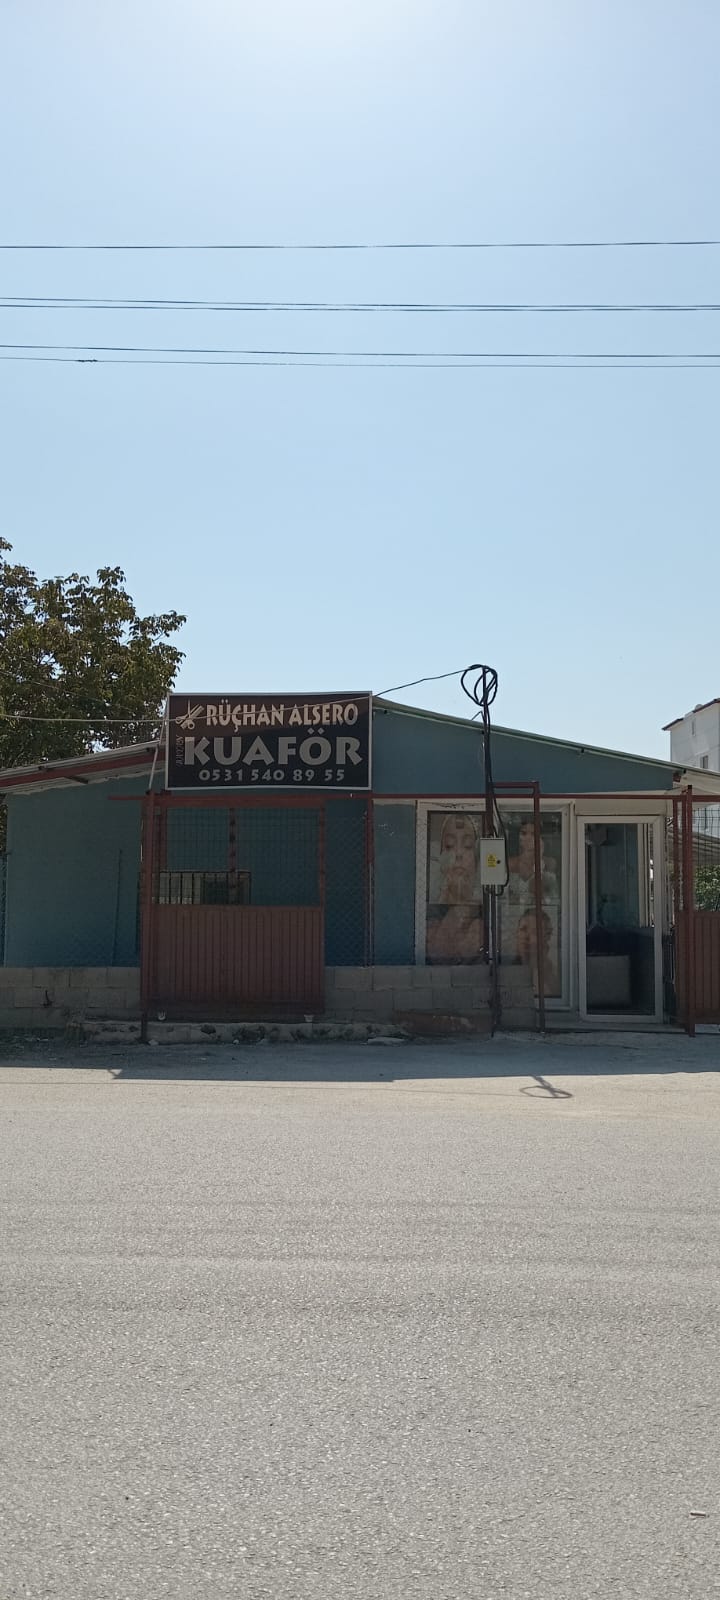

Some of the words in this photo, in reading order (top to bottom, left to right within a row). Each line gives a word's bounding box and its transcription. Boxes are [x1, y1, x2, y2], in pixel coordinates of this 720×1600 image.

[206, 698, 284, 732] RÜÇHAN
[288, 703, 358, 726] ALSERO
[184, 728, 363, 765] KUAFÖR
[199, 769, 243, 781] 0531
[251, 769, 285, 781] 540
[292, 769, 315, 781] 89
[324, 769, 345, 781] 55
